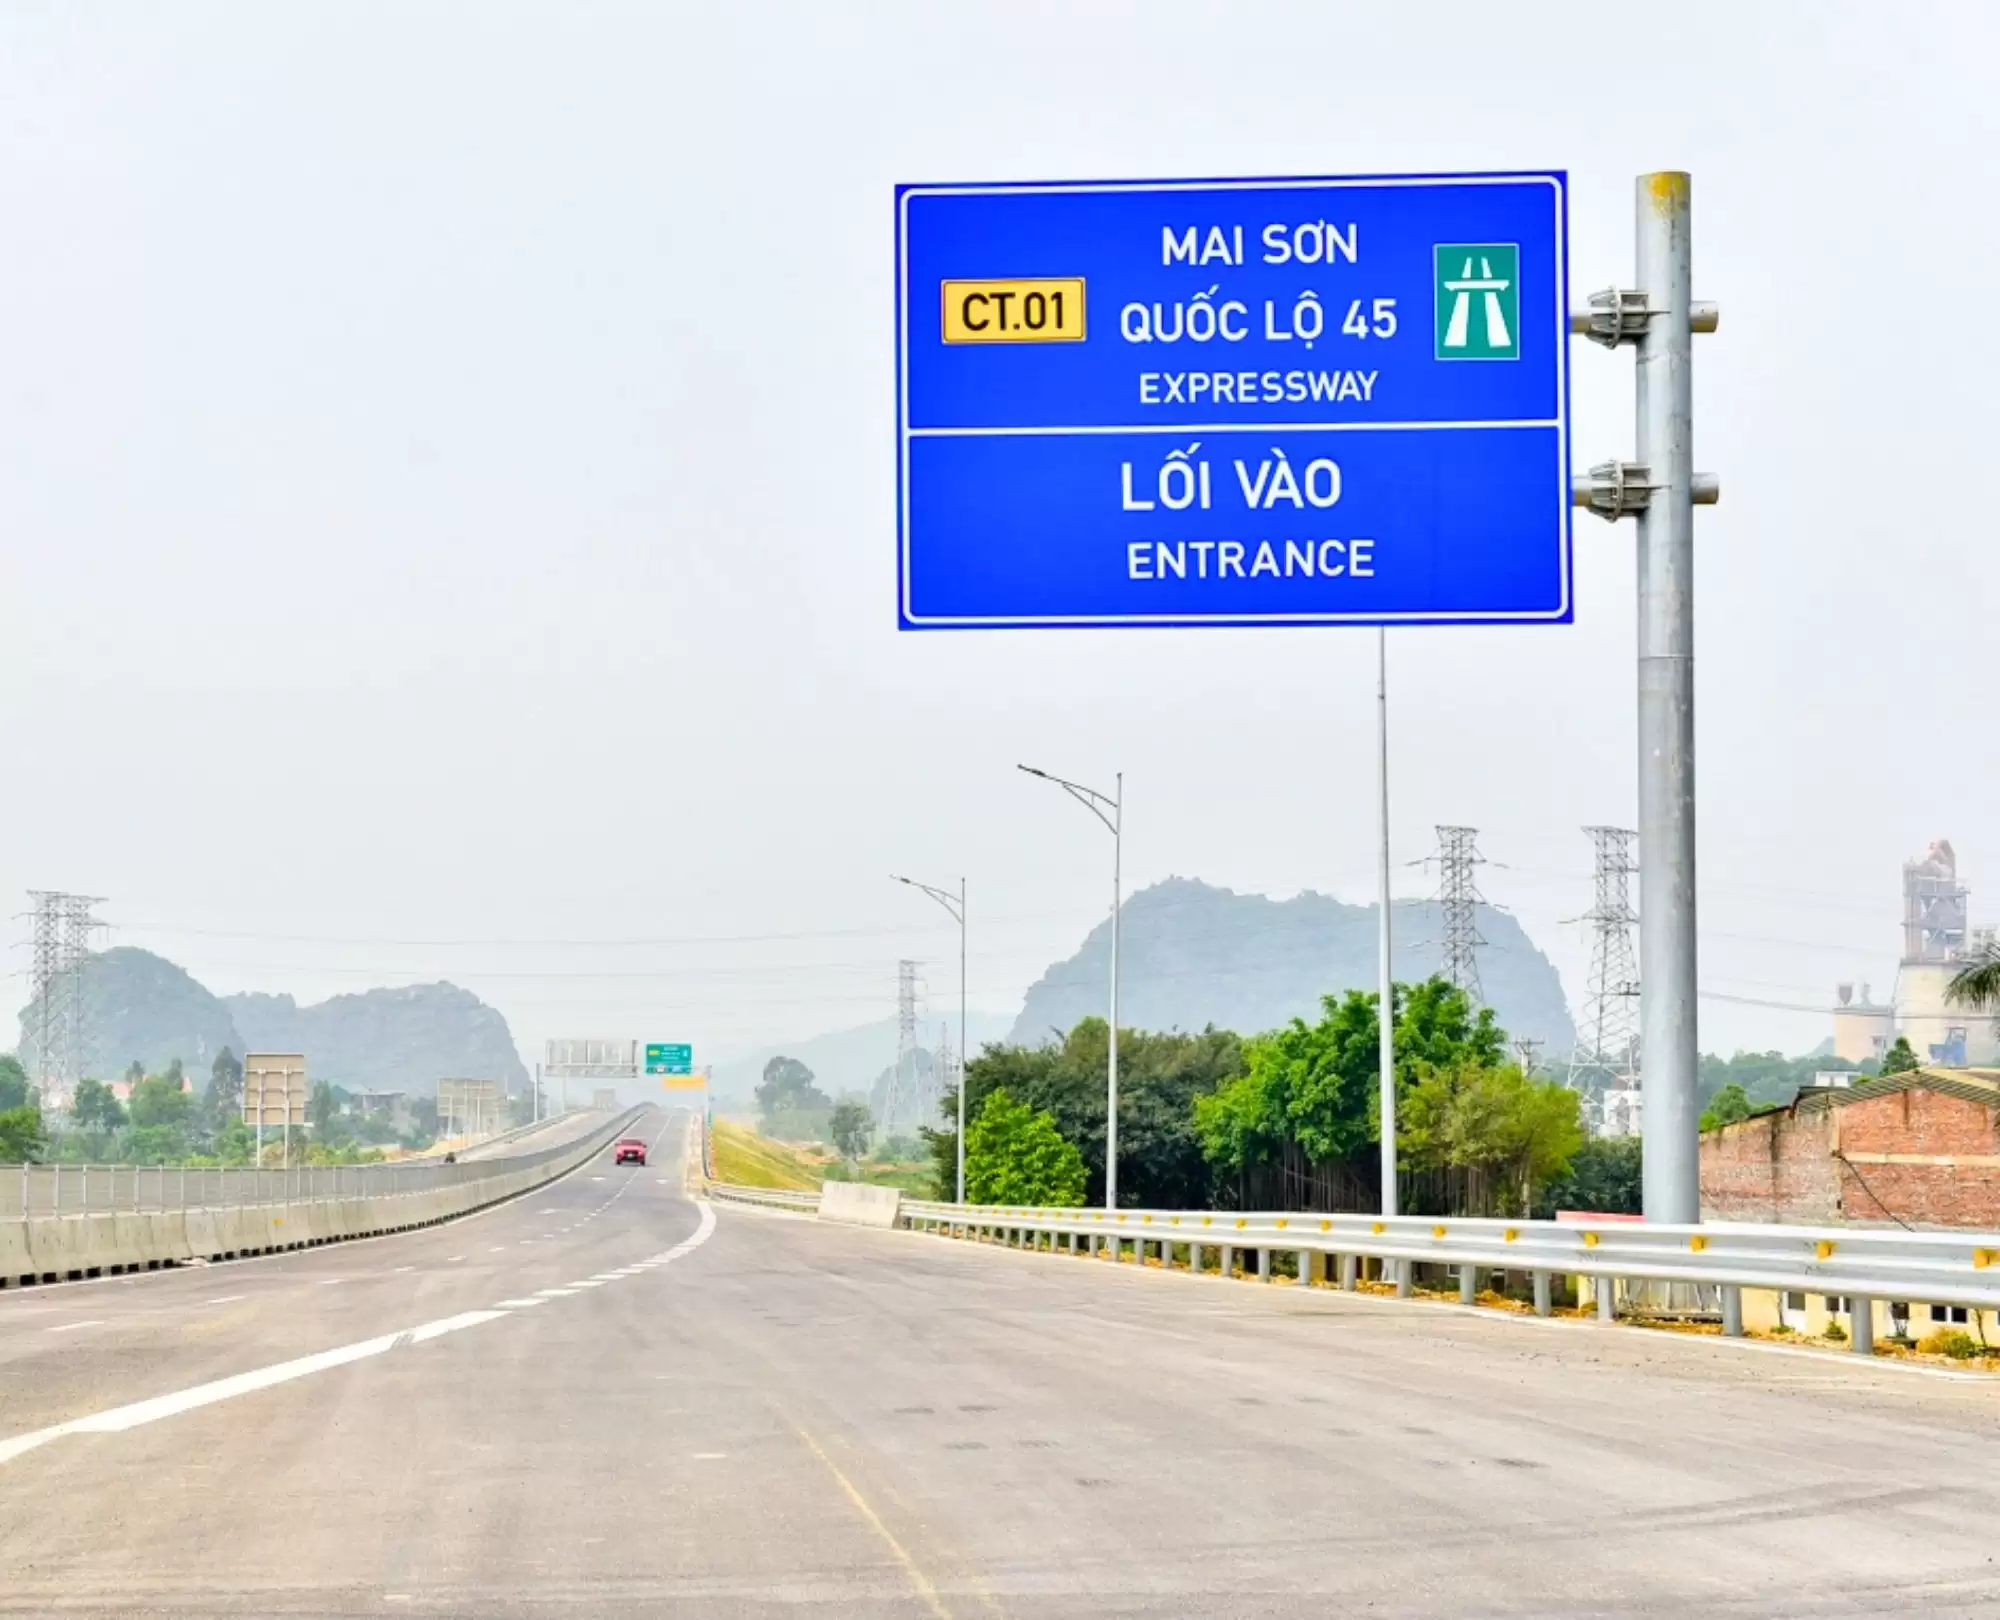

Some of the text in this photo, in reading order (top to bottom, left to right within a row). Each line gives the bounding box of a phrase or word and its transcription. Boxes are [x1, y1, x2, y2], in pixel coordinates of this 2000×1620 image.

[1163, 220, 1356, 265] MAI SƠN
[963, 292, 1063, 332] CT.01
[1121, 285, 1397, 349] QUỐC LỘ 45
[1140, 371, 1378, 404] EXPRESSWAY
[1122, 443, 1341, 511] LỐI VÀO
[1128, 540, 1375, 579] ENTRANCE
